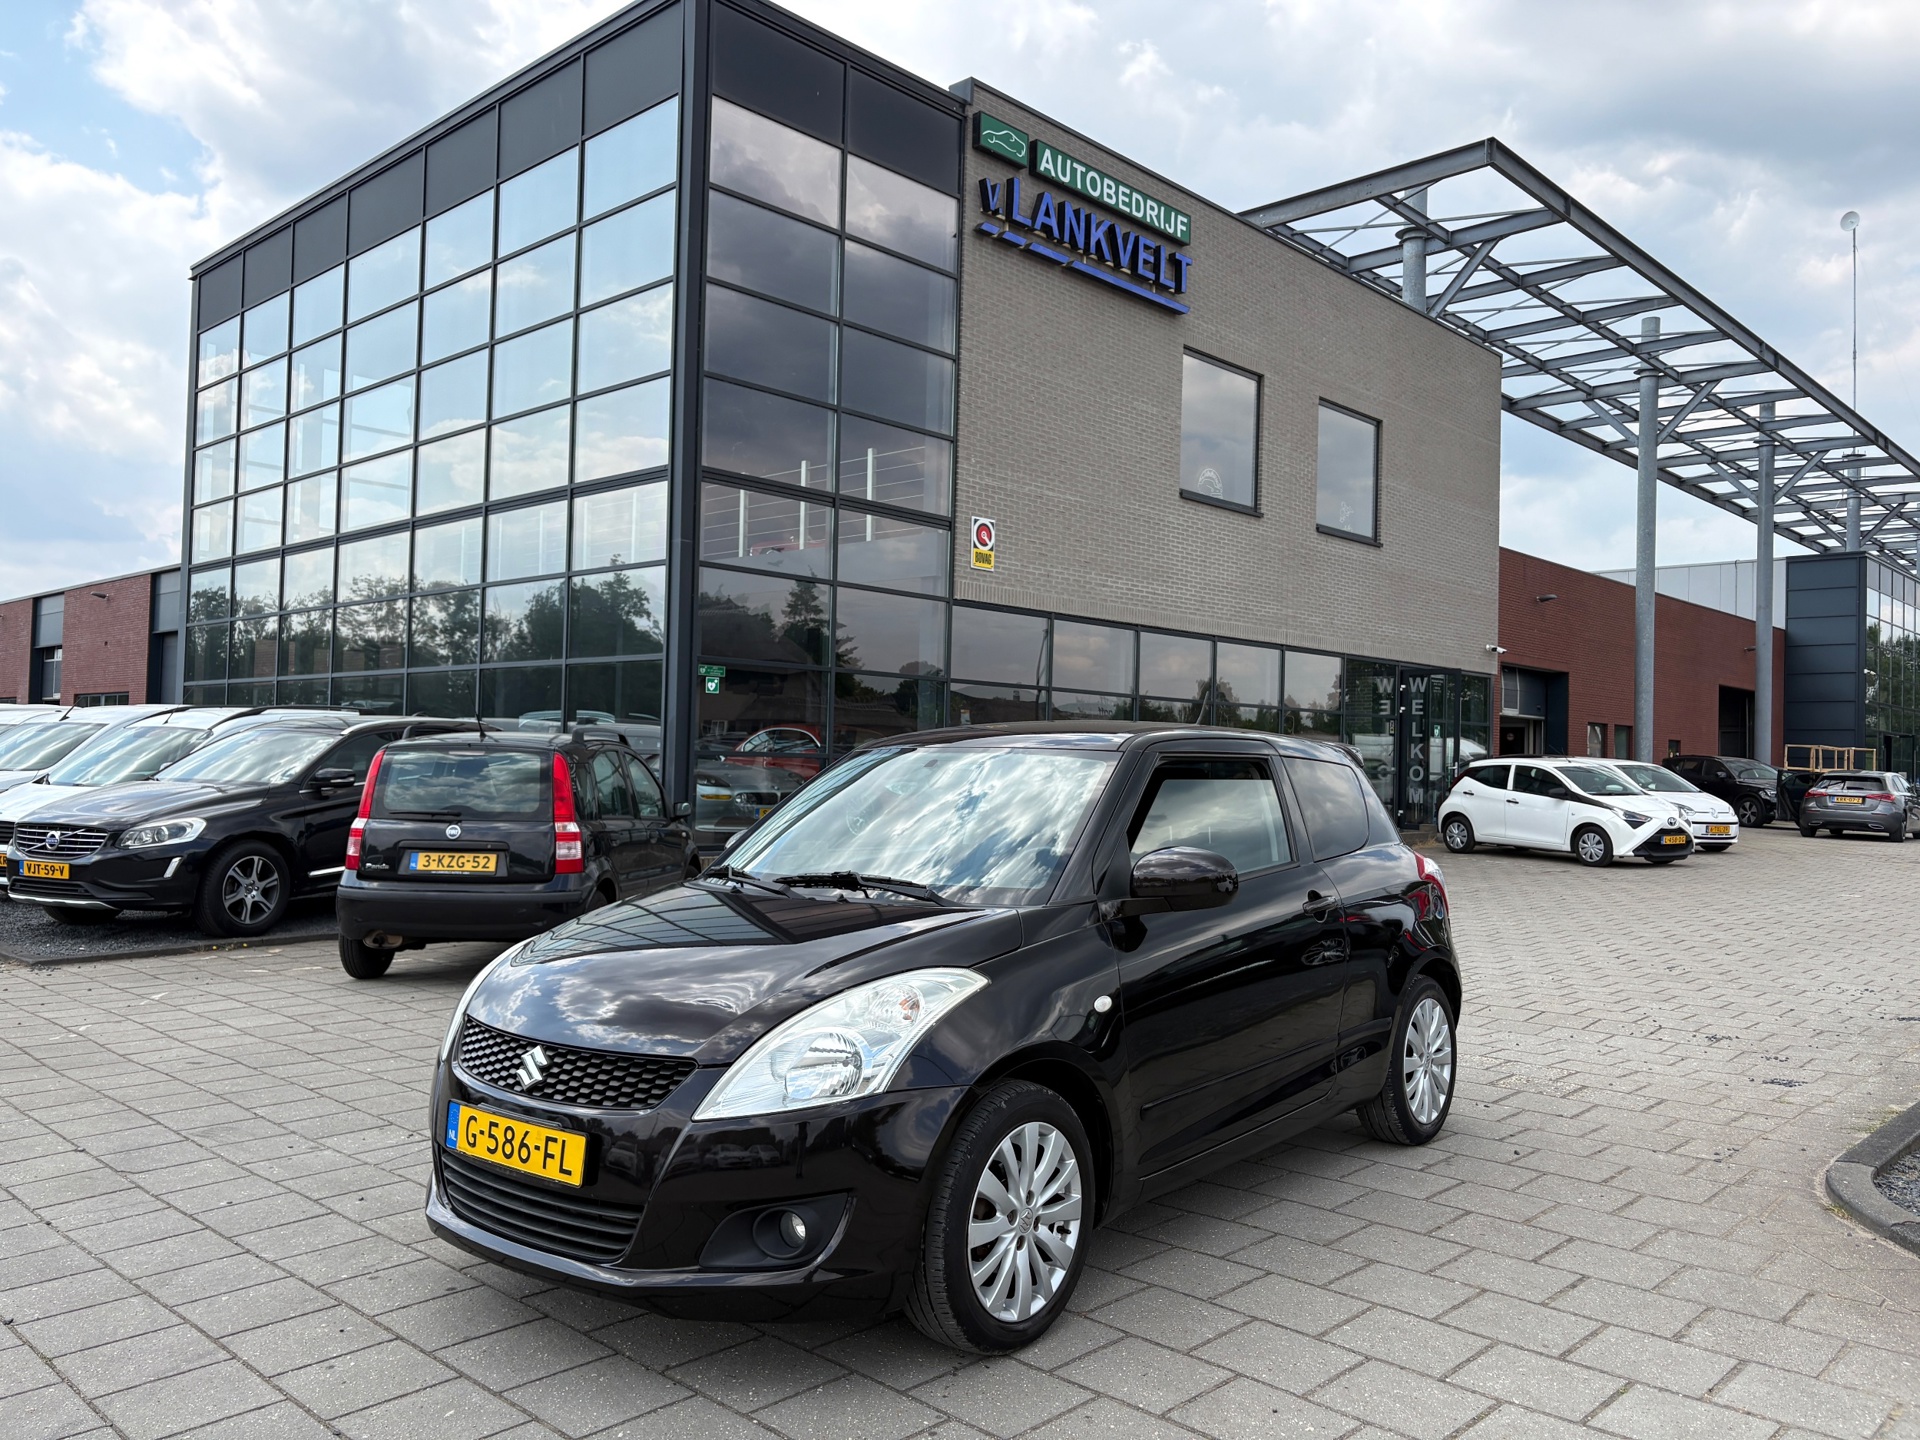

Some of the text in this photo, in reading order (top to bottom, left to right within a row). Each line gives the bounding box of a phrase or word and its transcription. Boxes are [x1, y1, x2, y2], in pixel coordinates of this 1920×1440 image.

[1040, 148, 1188, 238] AUTOBEDRIJF
[1006, 177, 1193, 295] LANKVELT
[975, 552, 992, 565] BOVAG
[1408, 677, 1428, 804] WELKOM
[26, 863, 65, 877] VJT-59-V
[422, 854, 491, 869] 3-KZG-52
[448, 1128, 457, 1141] NL
[465, 1115, 572, 1176] G-586-FL
